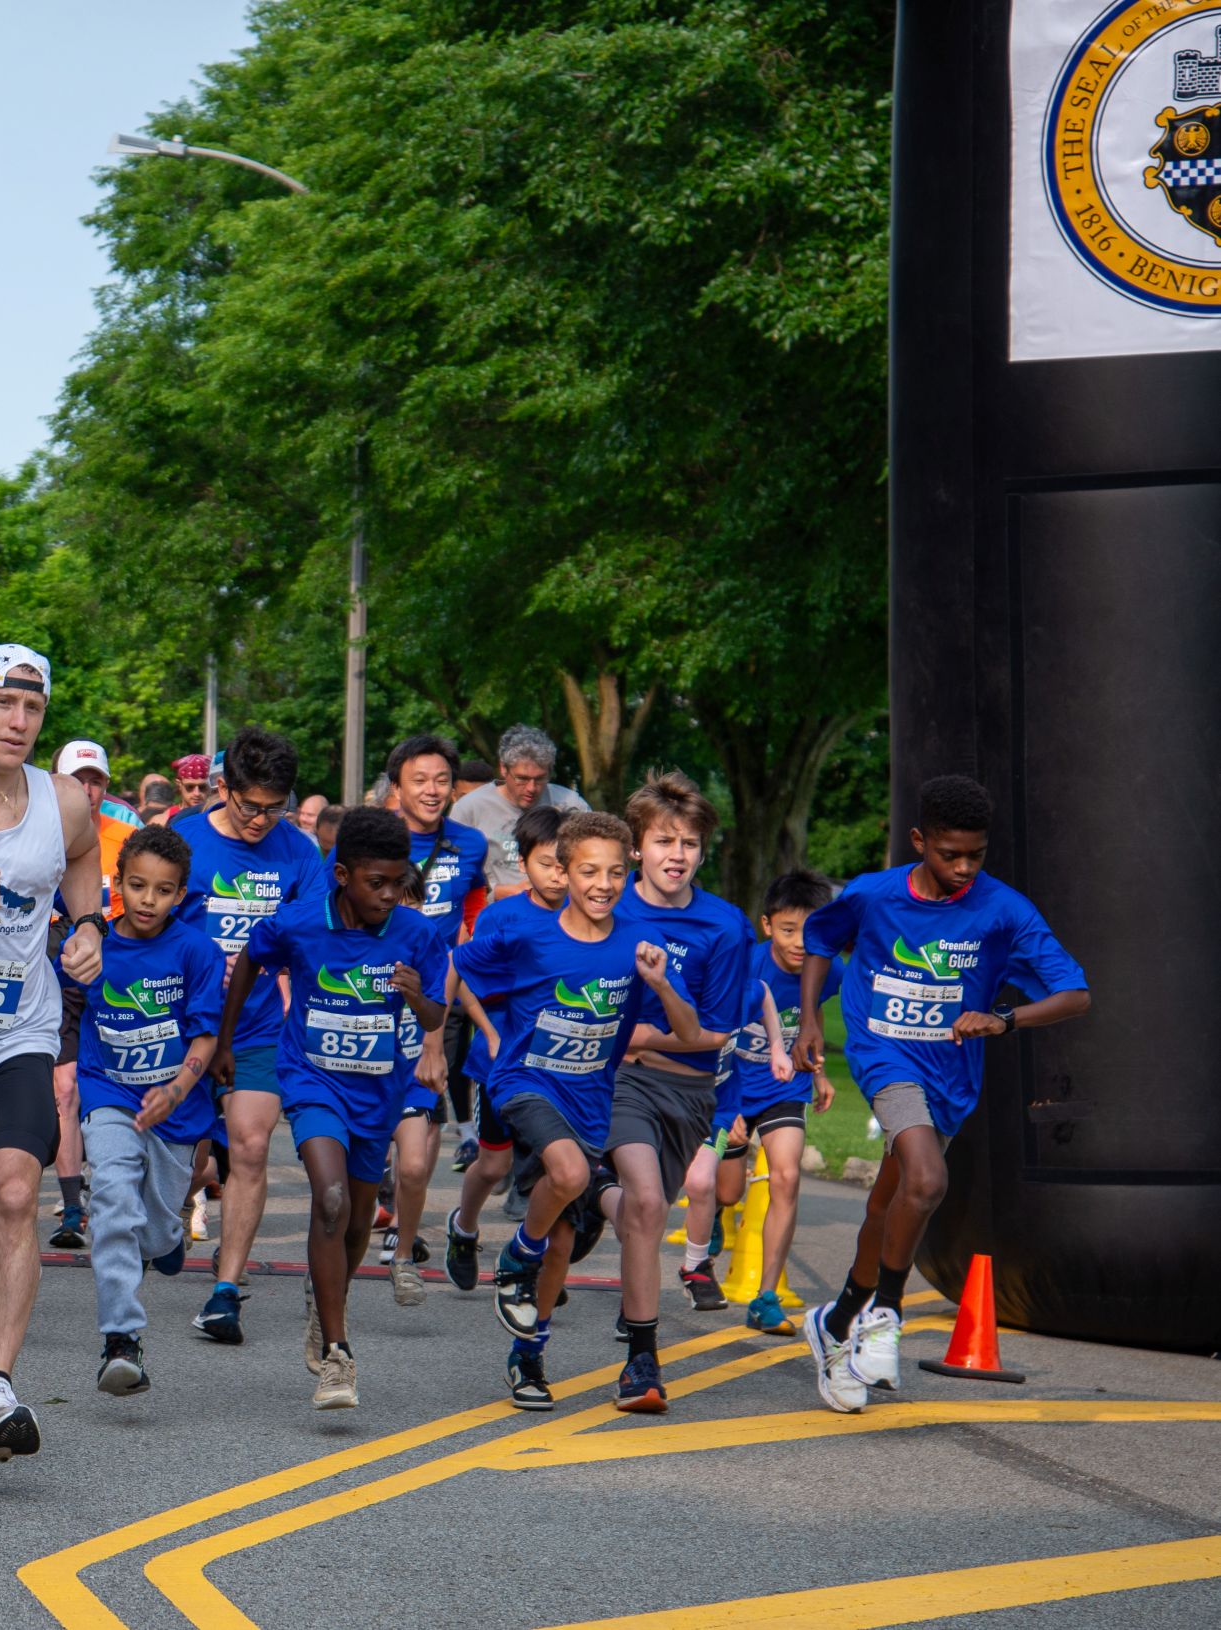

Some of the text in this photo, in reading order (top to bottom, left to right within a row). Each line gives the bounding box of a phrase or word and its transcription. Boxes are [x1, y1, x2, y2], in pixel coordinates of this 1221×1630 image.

[1122, 20, 1143, 38] OF
[1070, 42, 1125, 110] SEAL
[1064, 118, 1085, 180] THE
[1074, 202, 1119, 252] 1816
[1127, 254, 1219, 298] BENIG
[255, 883, 281, 897] Glide
[939, 939, 981, 951] Greenfield
[931, 953, 979, 969] 5K Glide
[362, 964, 395, 975] Greenfie
[905, 970, 923, 980] 2025
[143, 975, 184, 988] Greenfield
[356, 978, 367, 989] 5K
[139, 987, 184, 1005] 5K Glide
[592, 991, 604, 1002] 5K
[332, 999, 349, 1007] 2025
[97, 1011, 110, 1020] June
[543, 1007, 558, 1016] June
[566, 1011, 584, 1019] 2025
[885, 997, 944, 1026] 856
[894, 1029, 946, 1038] runhigh.com
[320, 1031, 379, 1058] 857
[546, 1034, 602, 1060] 728
[112, 1042, 166, 1070] 727
[331, 1062, 382, 1072] runhigh.com
[551, 1062, 598, 1071] runhigh.com
[127, 1070, 176, 1082] runhigh.com
